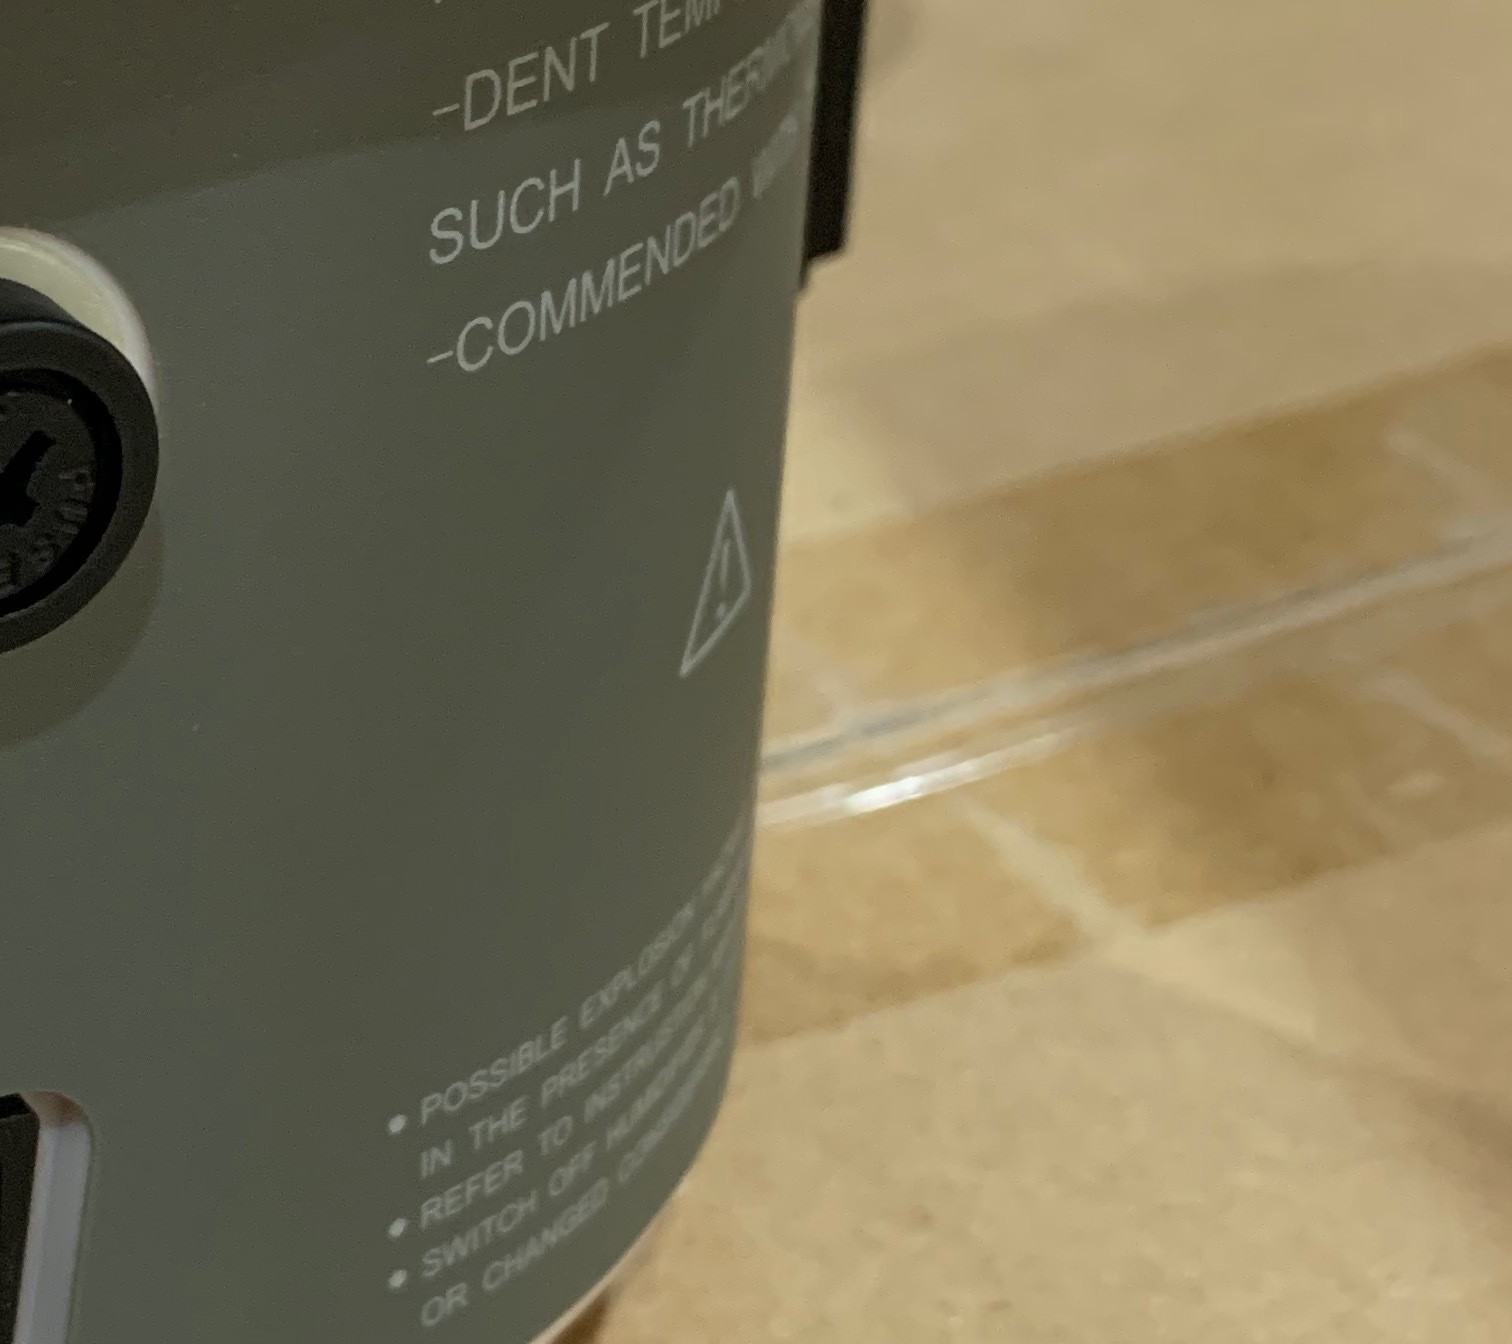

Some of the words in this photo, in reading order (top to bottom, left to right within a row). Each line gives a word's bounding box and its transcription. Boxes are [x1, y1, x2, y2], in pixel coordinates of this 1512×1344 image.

[429, 158, 582, 266] SUCH
[603, 119, 663, 196] AS
[420, 1015, 568, 1126] POSSIBLE
[420, 1138, 455, 1181] IN
[468, 1095, 530, 1151] THE
[420, 1150, 524, 1232] REFER
[537, 1115, 575, 1158] TO
[420, 1190, 538, 1279] SWITCH
[420, 1282, 468, 1328] OR
